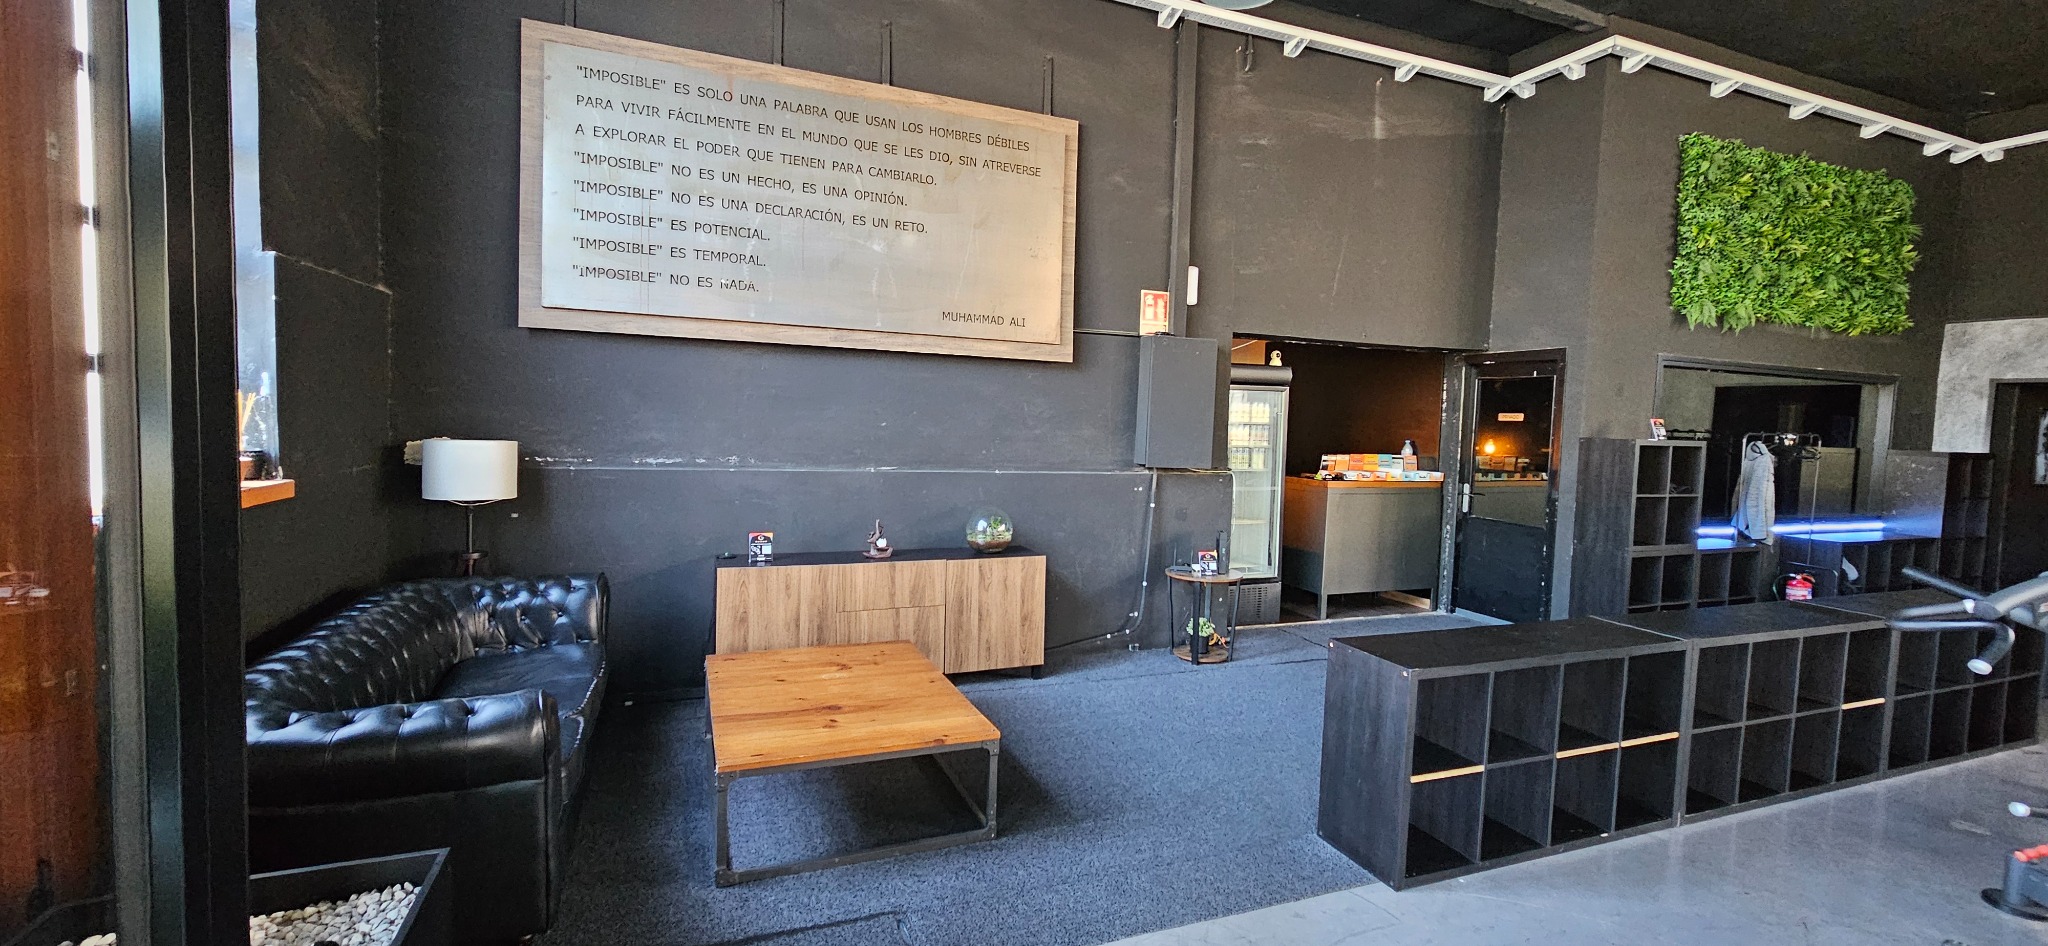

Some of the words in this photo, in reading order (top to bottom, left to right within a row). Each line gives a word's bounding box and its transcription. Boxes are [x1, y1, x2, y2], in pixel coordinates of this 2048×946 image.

[576, 65, 666, 91] "IMPOSIBLE"
[674, 82, 690, 95] ES
[697, 86, 733, 102] SOLO
[740, 94, 767, 108] UNA
[774, 99, 828, 118] PALABRA
[834, 110, 859, 124] QUE
[865, 114, 896, 130] USAN
[902, 122, 924, 134] LOS
[929, 125, 982, 144] HOMBRES
[987, 133, 1030, 152] DÉBILES
[576, 95, 614, 111] PARA
[621, 102, 660, 118] VIVIR
[668, 107, 751, 132] FÁCILMENTE
[758, 123, 775, 136] EN
[781, 127, 796, 140] EL
[802, 130, 848, 147] MUNDO
[854, 139, 878, 153] QUE
[884, 143, 898, 155] SE
[904, 147, 924, 159] LES
[929, 150, 953, 165] DIO,
[958, 155, 977, 168] SIN
[982, 159, 1041, 177] ATREVERSE
[573, 151, 664, 173] "IMPOSIBLE"
[671, 164, 692, 178] NO
[699, 168, 715, 181] ES
[722, 171, 740, 184] UN
[747, 174, 795, 194] HECHO,
[802, 182, 817, 194] ES
[823, 185, 848, 199] UNA
[854, 189, 908, 207] OPINIÓN.
[575, 124, 585, 135] A
[593, 126, 666, 147] EXPLORAR
[674, 138, 689, 150] EL
[696, 140, 740, 158] PODER
[747, 148, 774, 163] QUE
[780, 153, 826, 169] TIENEN
[832, 161, 864, 175] PARA
[868, 166, 937, 186] CAMBIARLO.
[573, 179, 664, 202] "IMPOSIBLE"
[671, 192, 691, 205] NO
[698, 195, 715, 207] ES
[721, 198, 749, 212] UNA
[755, 202, 846, 226] DECLARACIÓN,
[852, 215, 866, 226] ES
[872, 217, 889, 229] UN
[895, 221, 928, 234] RETO.
[573, 208, 663, 229] "IMPOSIBLE"
[670, 220, 687, 232] ES
[694, 222, 771, 241] POTENCIAL.
[572, 264, 662, 284] "IMPOSIBLE"
[669, 274, 690, 286] NO
[697, 276, 713, 288] ES
[720, 278, 760, 292] NADA.
[573, 236, 663, 256] "IMPOSIBLE"
[670, 247, 687, 259] ES
[693, 249, 766, 267] TEMPORAL.
[942, 311, 1005, 326] MUHAMMAD
[1009, 316, 1026, 328] ALI
